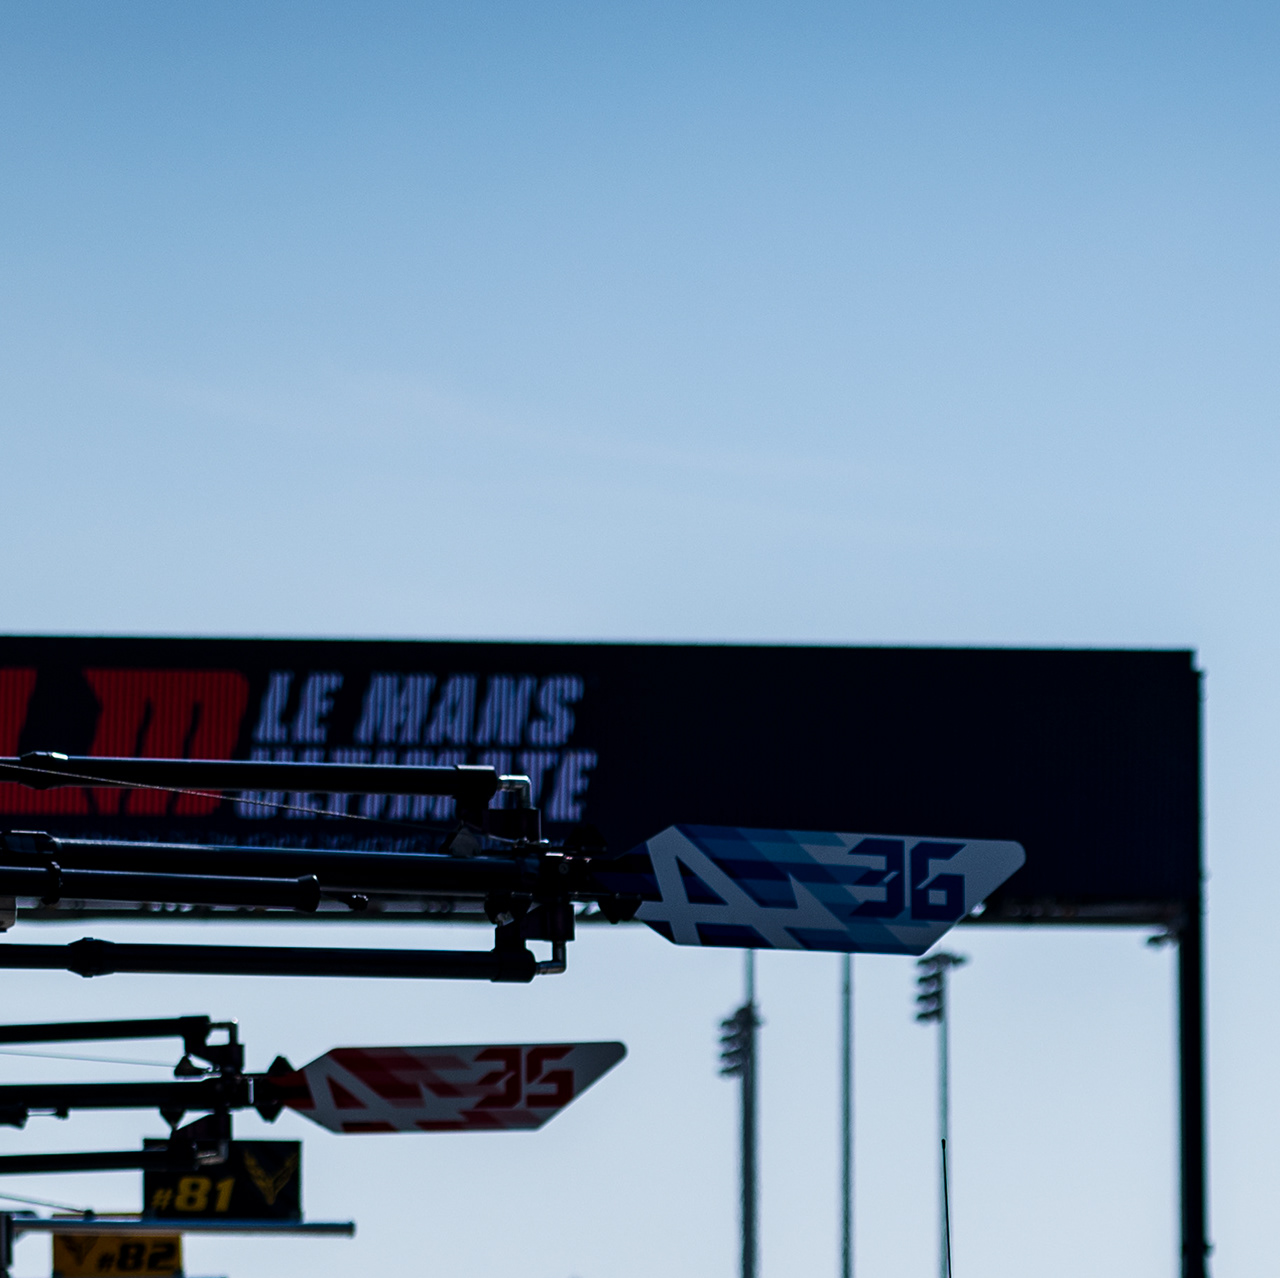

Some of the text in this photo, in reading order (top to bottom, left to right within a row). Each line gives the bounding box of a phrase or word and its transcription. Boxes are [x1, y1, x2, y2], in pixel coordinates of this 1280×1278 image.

[253, 670, 586, 747] LE MANS
[847, 837, 968, 922] 36
[474, 1046, 577, 1110] 35
[151, 1175, 237, 1213] #81
[96, 1242, 179, 1272] #82
